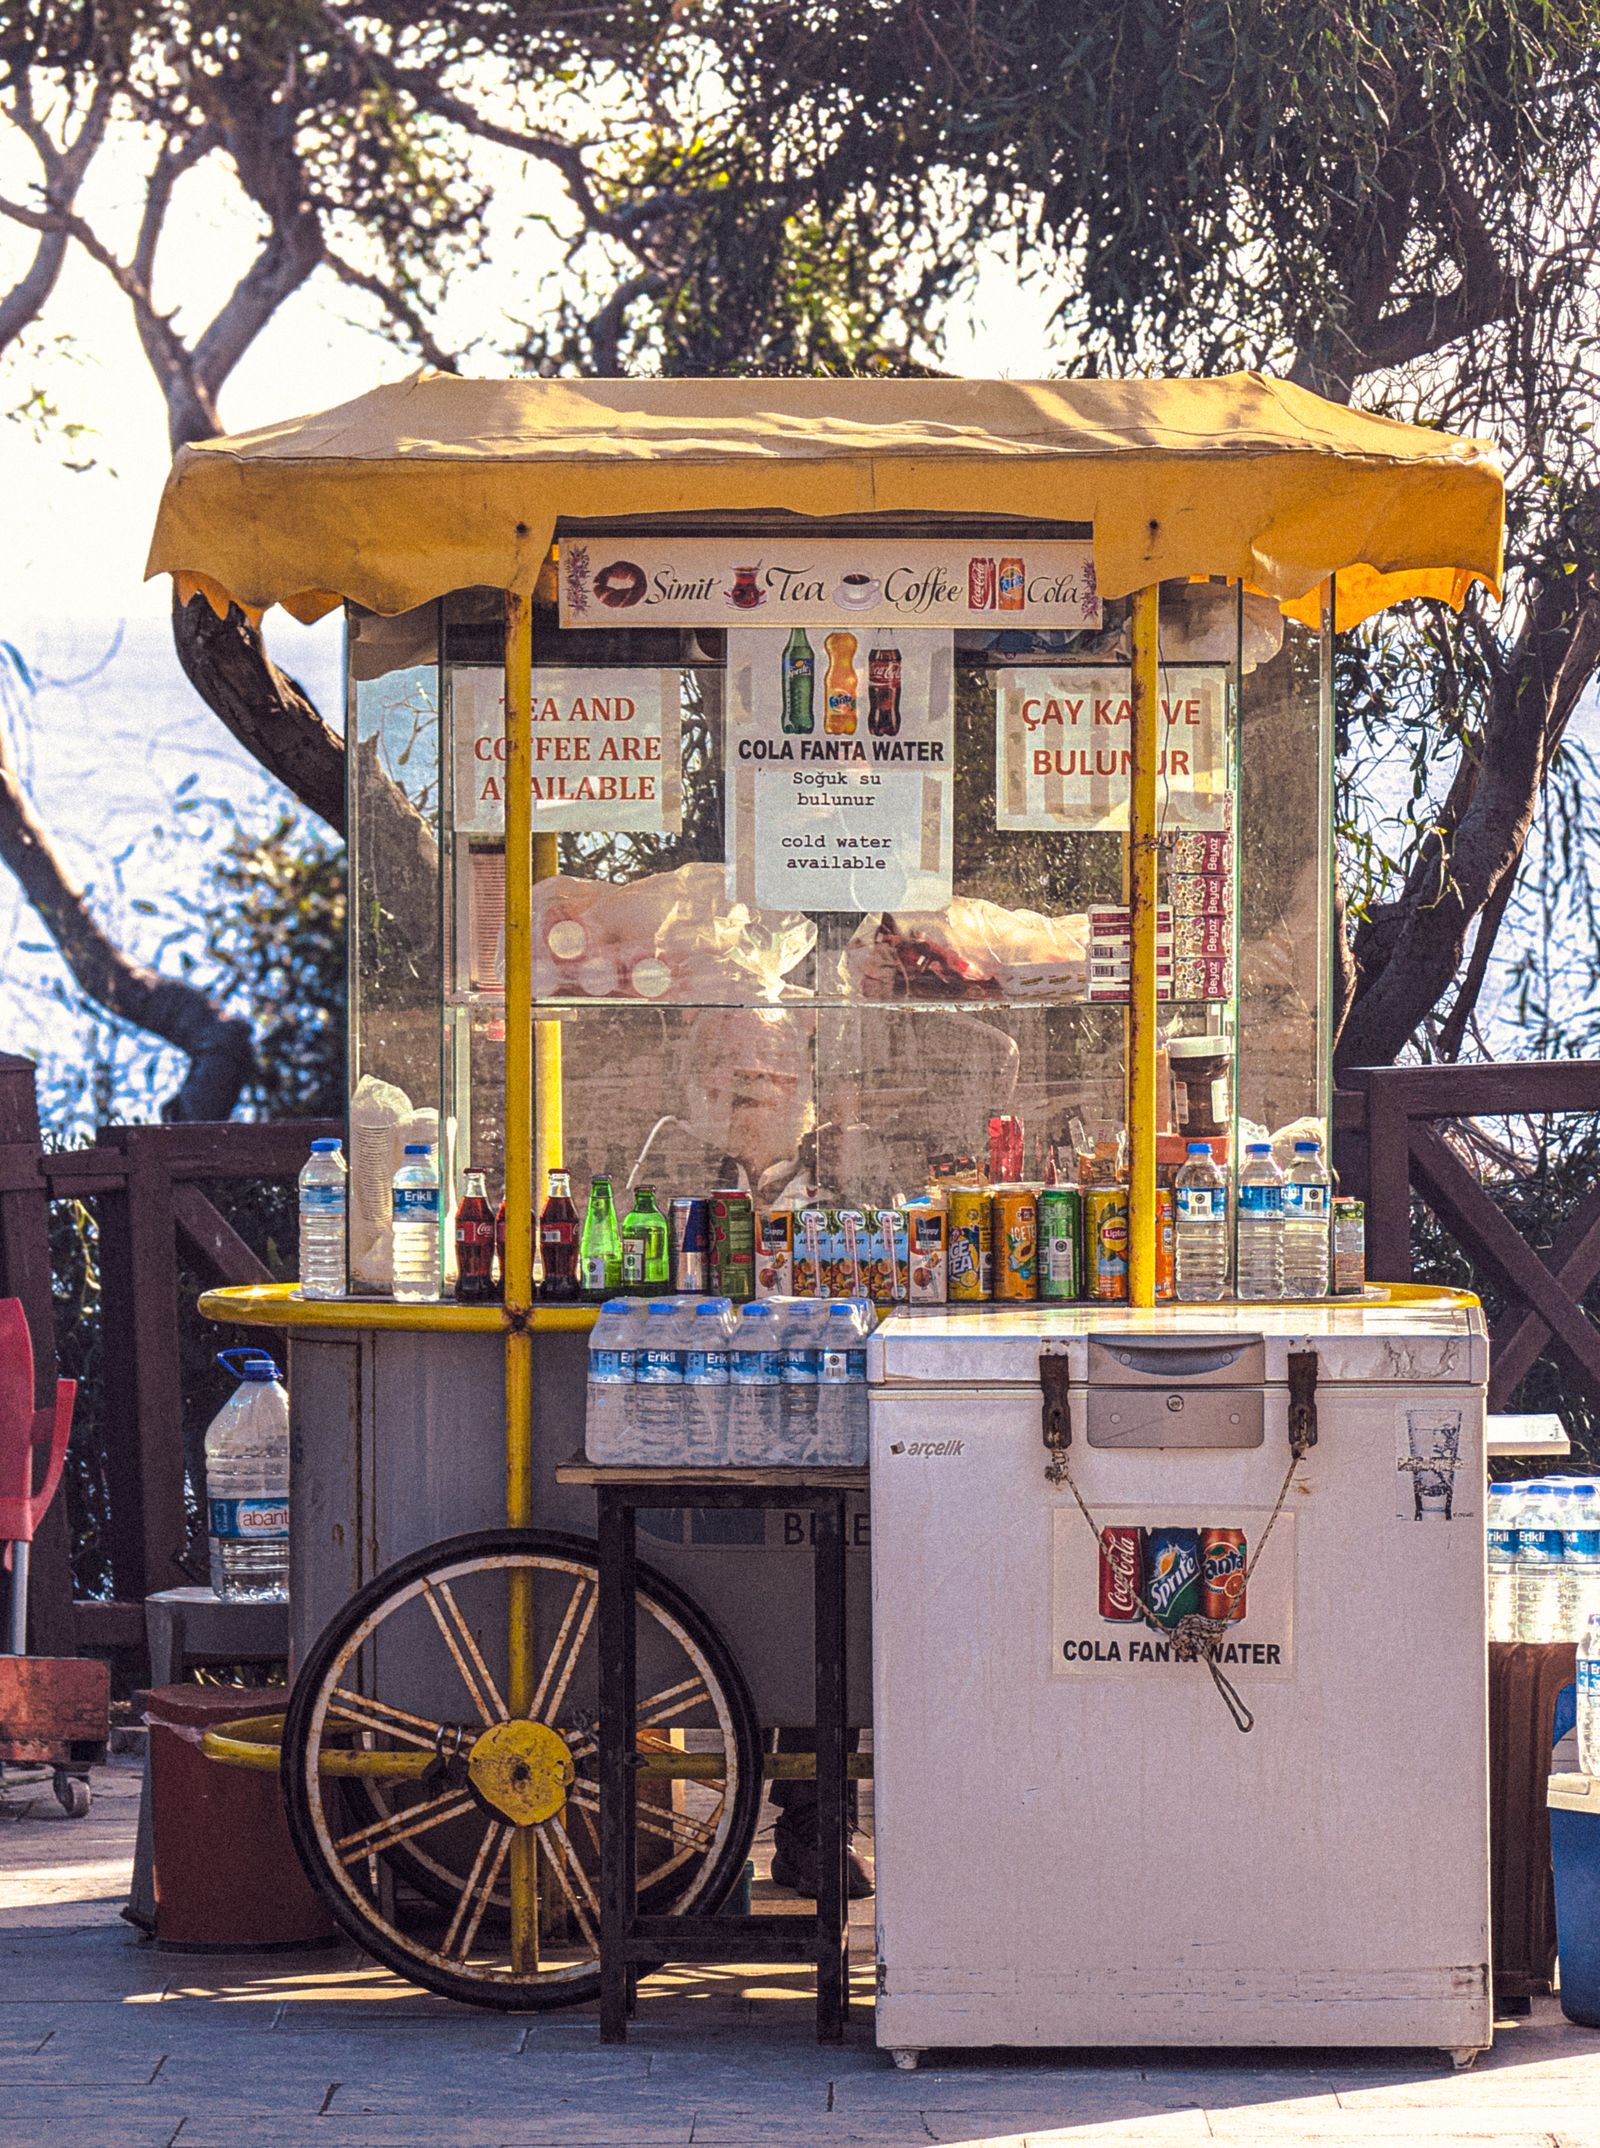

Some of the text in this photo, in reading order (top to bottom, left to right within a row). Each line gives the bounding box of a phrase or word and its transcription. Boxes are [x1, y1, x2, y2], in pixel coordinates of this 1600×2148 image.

[645, 564, 1084, 615] Simit Tea Coffee Cola
[569, 697, 636, 722] AND
[1022, 699, 1201, 731] ÇAY KAVE
[474, 736, 662, 762] COFEE ARE
[738, 739, 944, 762] COLA FANTA WATER
[480, 777, 655, 801] AAILABLE
[793, 771, 882, 790] Soğuk su
[797, 793, 876, 807] bulunur
[781, 835, 892, 849] cold water
[786, 855, 887, 870] available
[404, 1190, 433, 1203] Erikli
[648, 1351, 676, 1363] Erikli
[907, 1439, 965, 1460] arçelik
[1519, 1530, 1545, 1543] Erikli
[1151, 1552, 1196, 1612] Sprite
[1063, 1639, 1121, 1662] COLA
[1208, 1643, 1281, 1665] WATER
